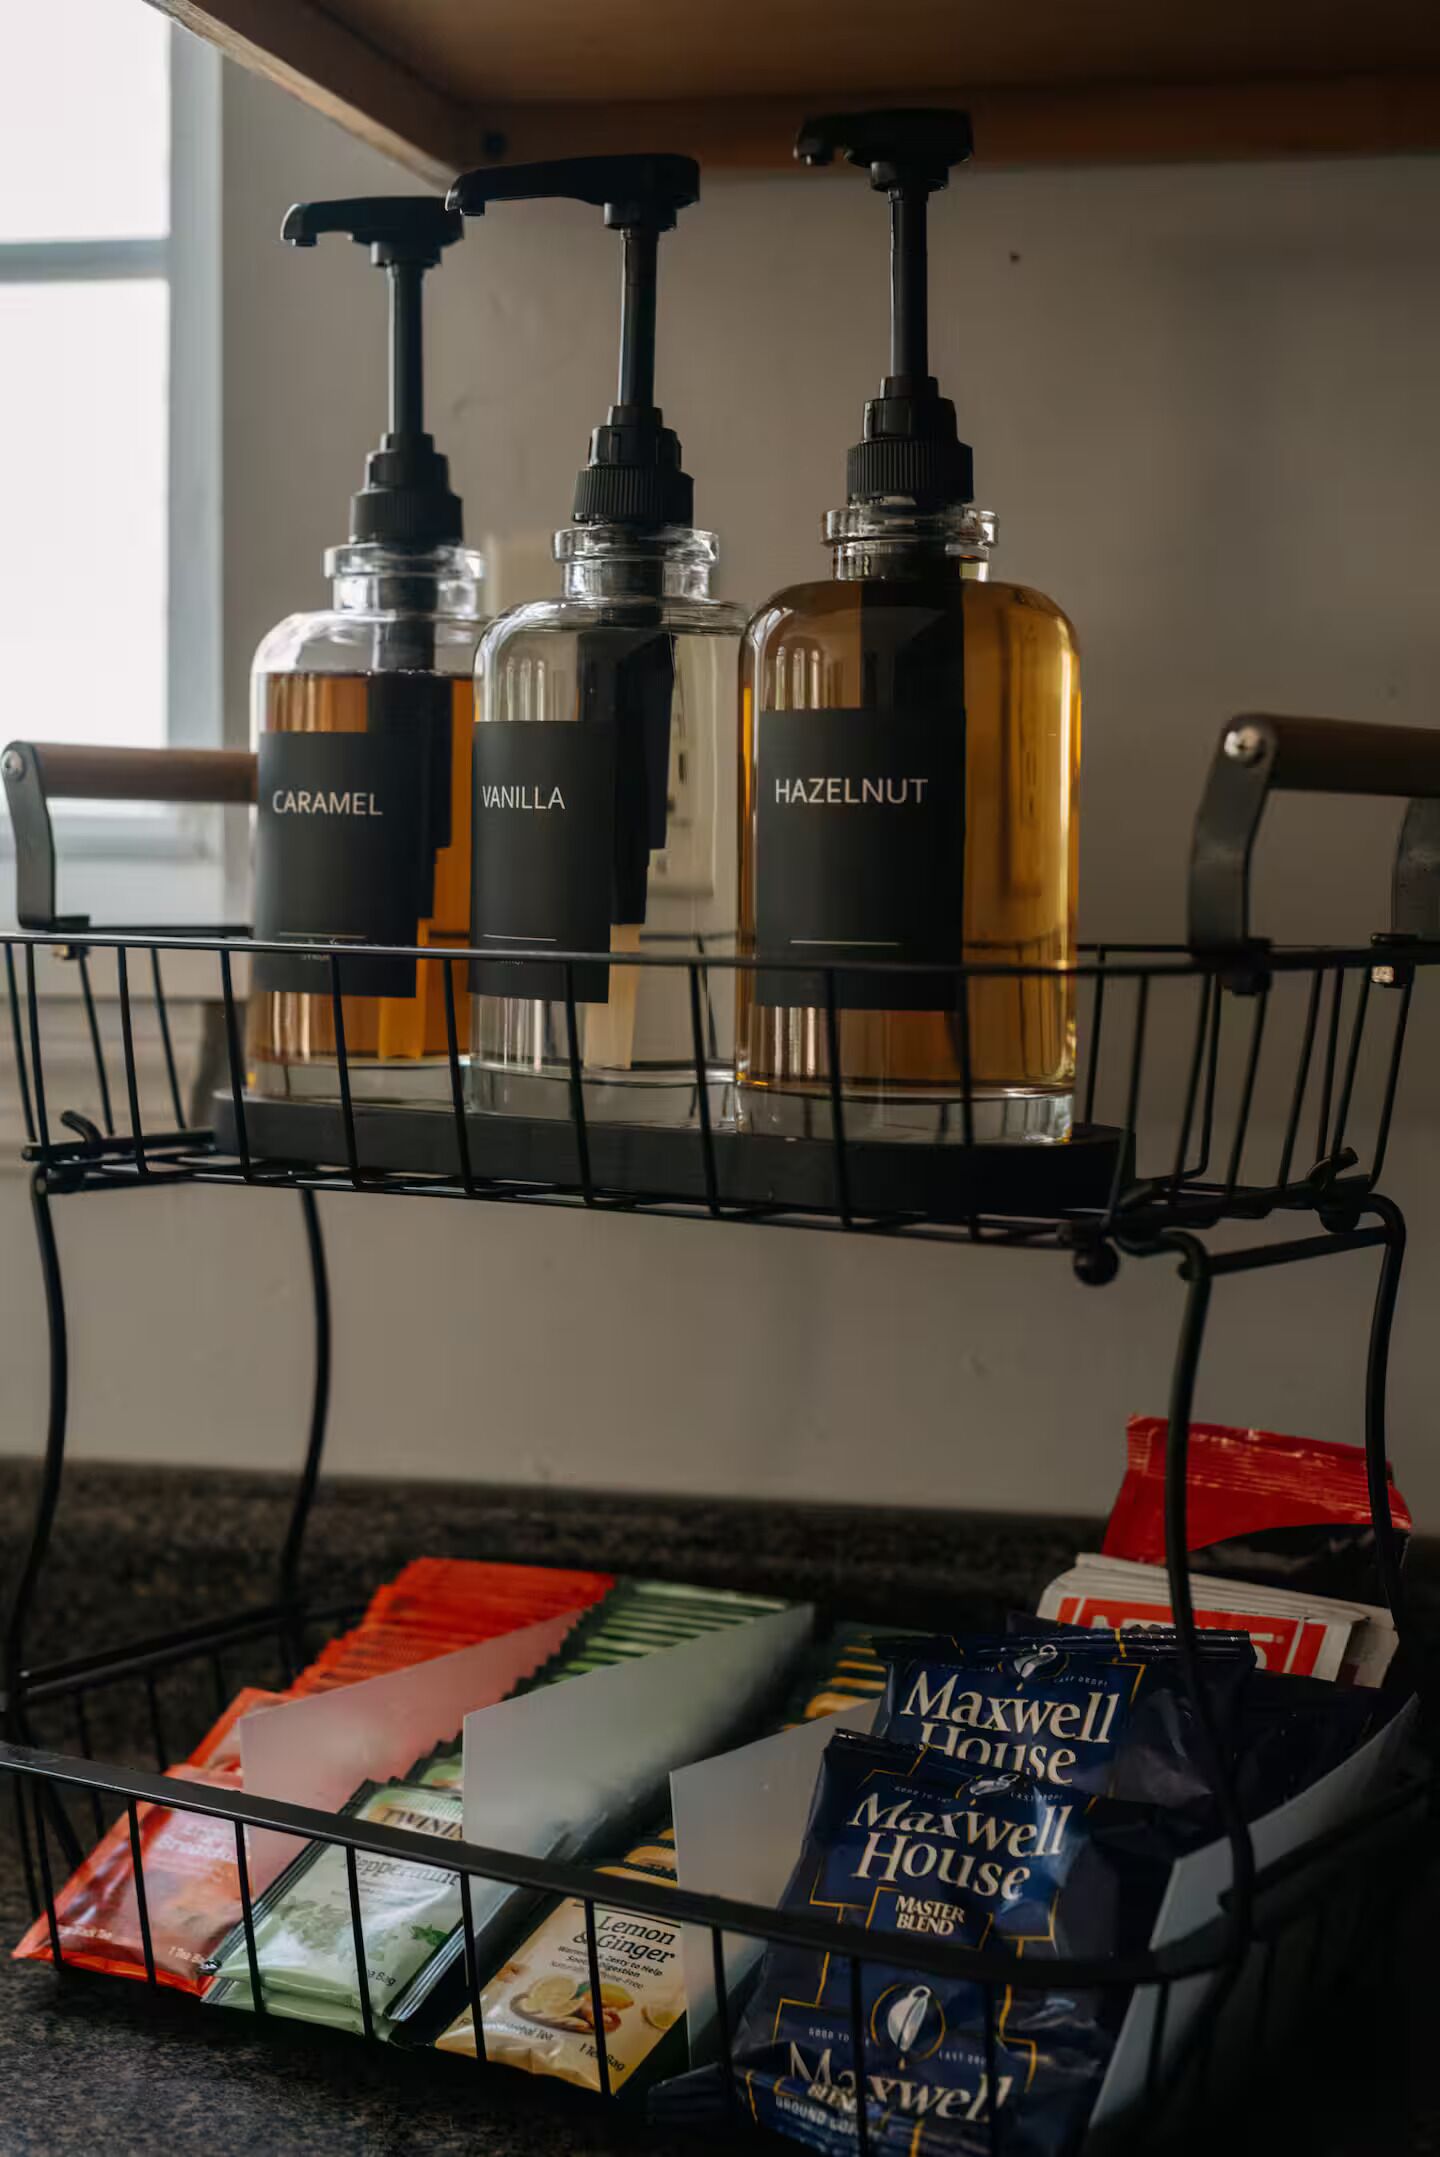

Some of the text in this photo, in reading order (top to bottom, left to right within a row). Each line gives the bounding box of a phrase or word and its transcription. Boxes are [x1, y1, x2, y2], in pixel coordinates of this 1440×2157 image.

[272, 789, 383, 816] CARAMEL
[481, 785, 566, 810] VANILLA
[774, 777, 929, 805] HAZELNUT
[899, 1670, 1120, 1744] Maxwell
[919, 1721, 1077, 1785] House
[846, 1792, 1073, 1857] Maxwell
[355, 1856, 461, 1886] eppermint
[850, 1832, 1031, 1900] House
[896, 1895, 965, 1924] MASTER
[896, 1912, 955, 1936] BLEND
[598, 1916, 676, 1945] Lemon
[597, 1934, 676, 1963] Ginger
